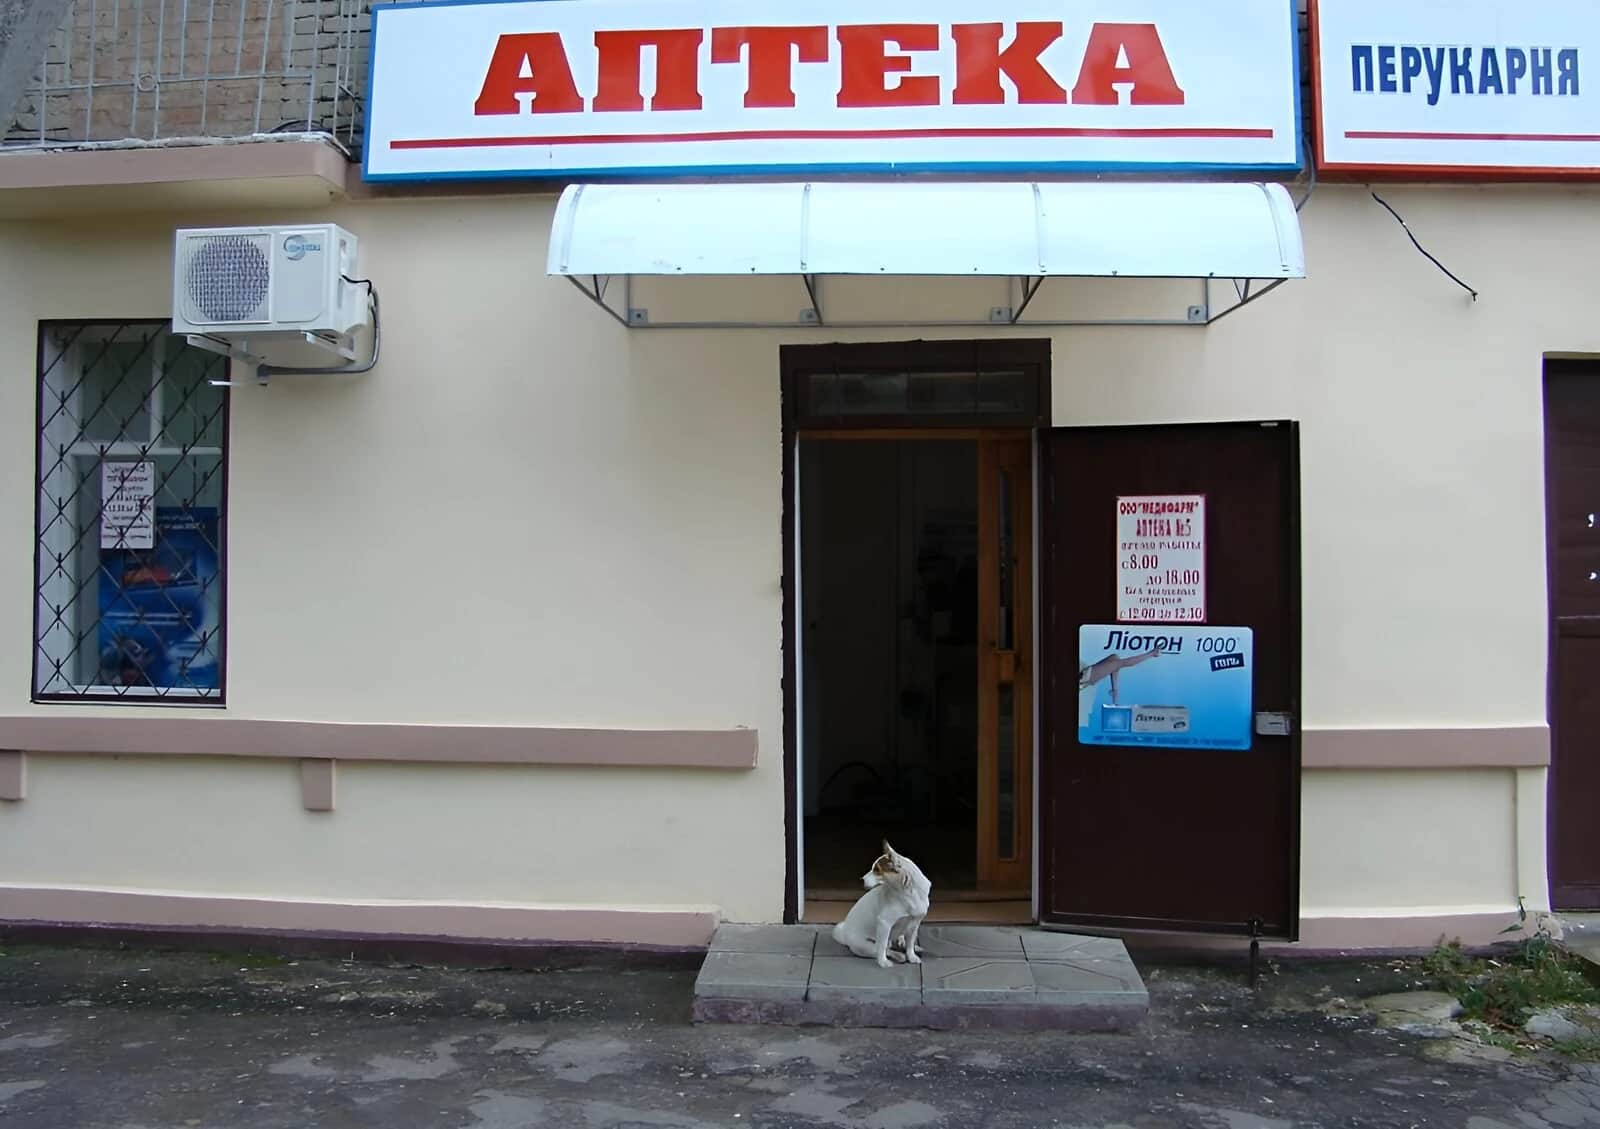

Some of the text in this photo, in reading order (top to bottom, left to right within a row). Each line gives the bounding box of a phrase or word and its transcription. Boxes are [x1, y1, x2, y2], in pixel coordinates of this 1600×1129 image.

[474, 21, 1184, 116] АПТЕКА
[1351, 45, 1580, 106] ПЕРУКАРНЯ
[1136, 519, 1171, 537] АПТЕКА
[1129, 554, 1158, 569] 8.00
[1165, 569, 1200, 585] 18.00
[1104, 630, 1236, 653] Ліотон 1000
